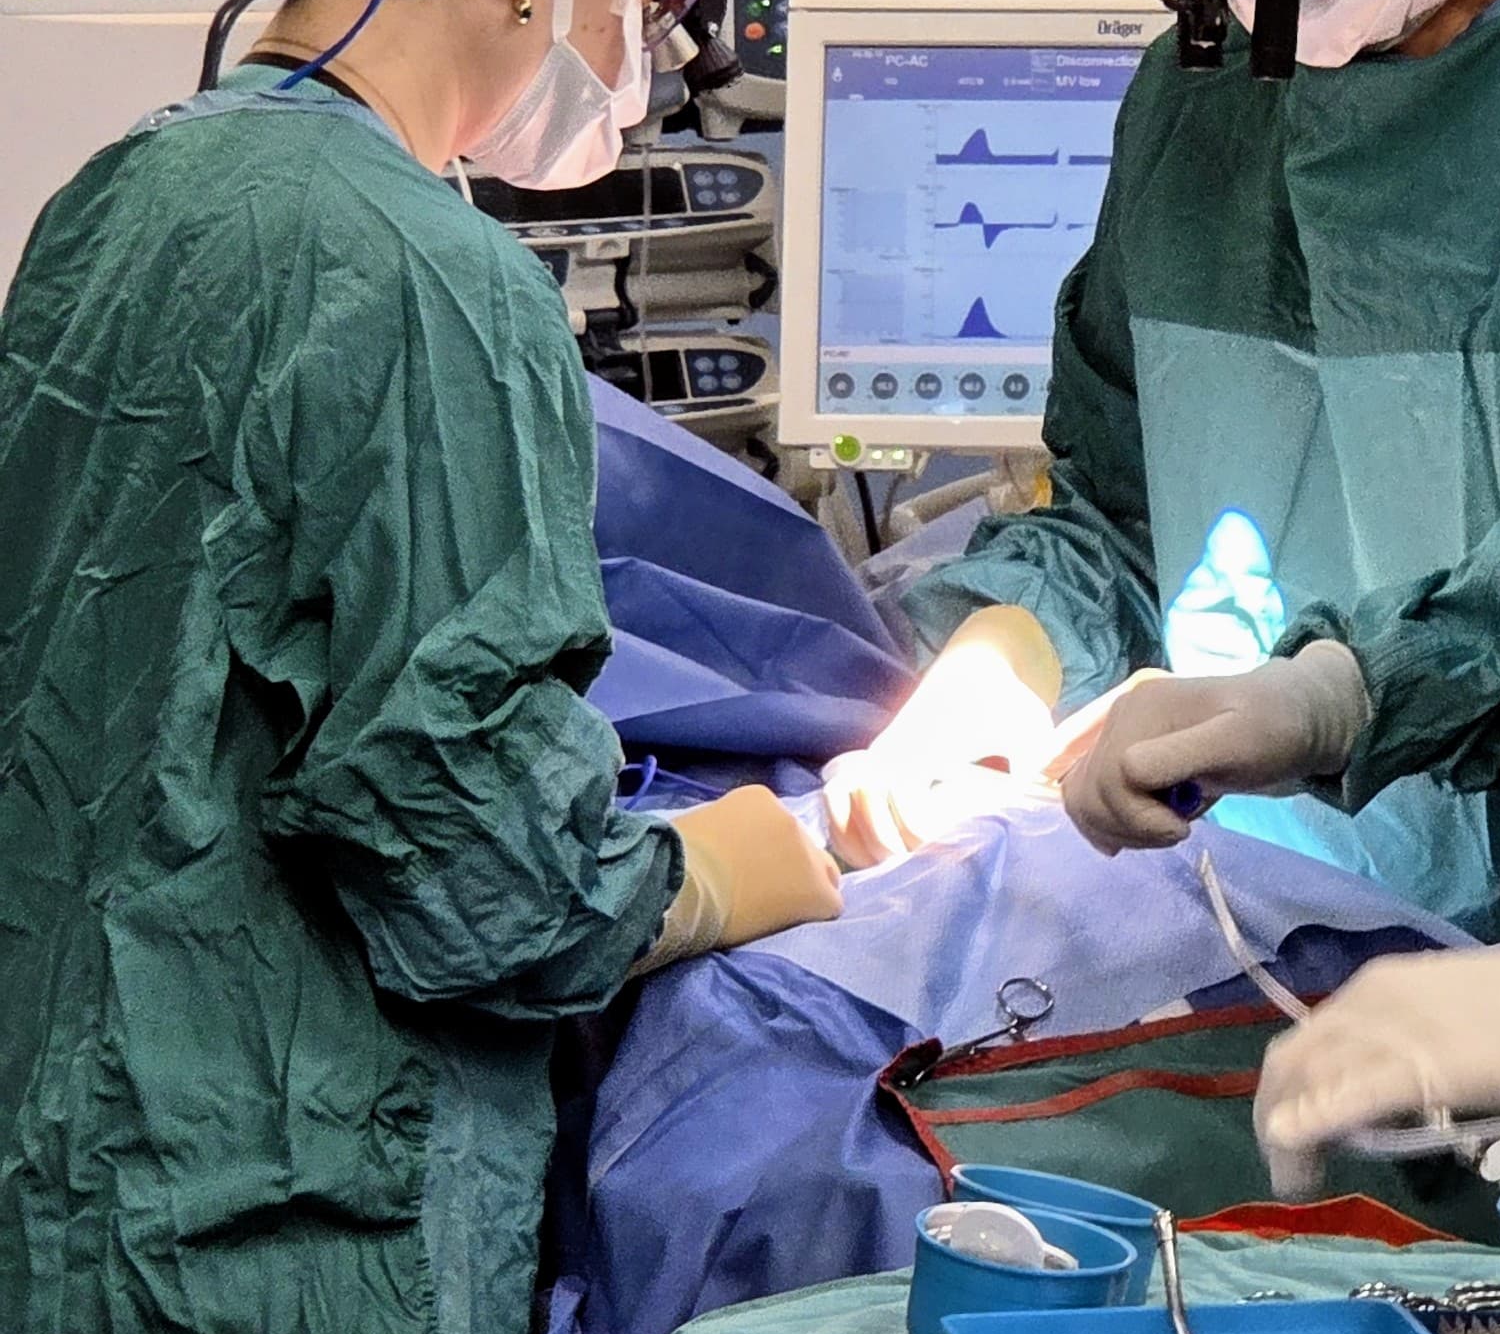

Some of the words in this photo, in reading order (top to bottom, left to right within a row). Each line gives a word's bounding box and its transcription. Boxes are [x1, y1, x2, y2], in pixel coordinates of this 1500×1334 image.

[1097, 19, 1143, 38] Dräger
[885, 54, 928, 67] PC-AC
[1056, 75, 1077, 87] MV
